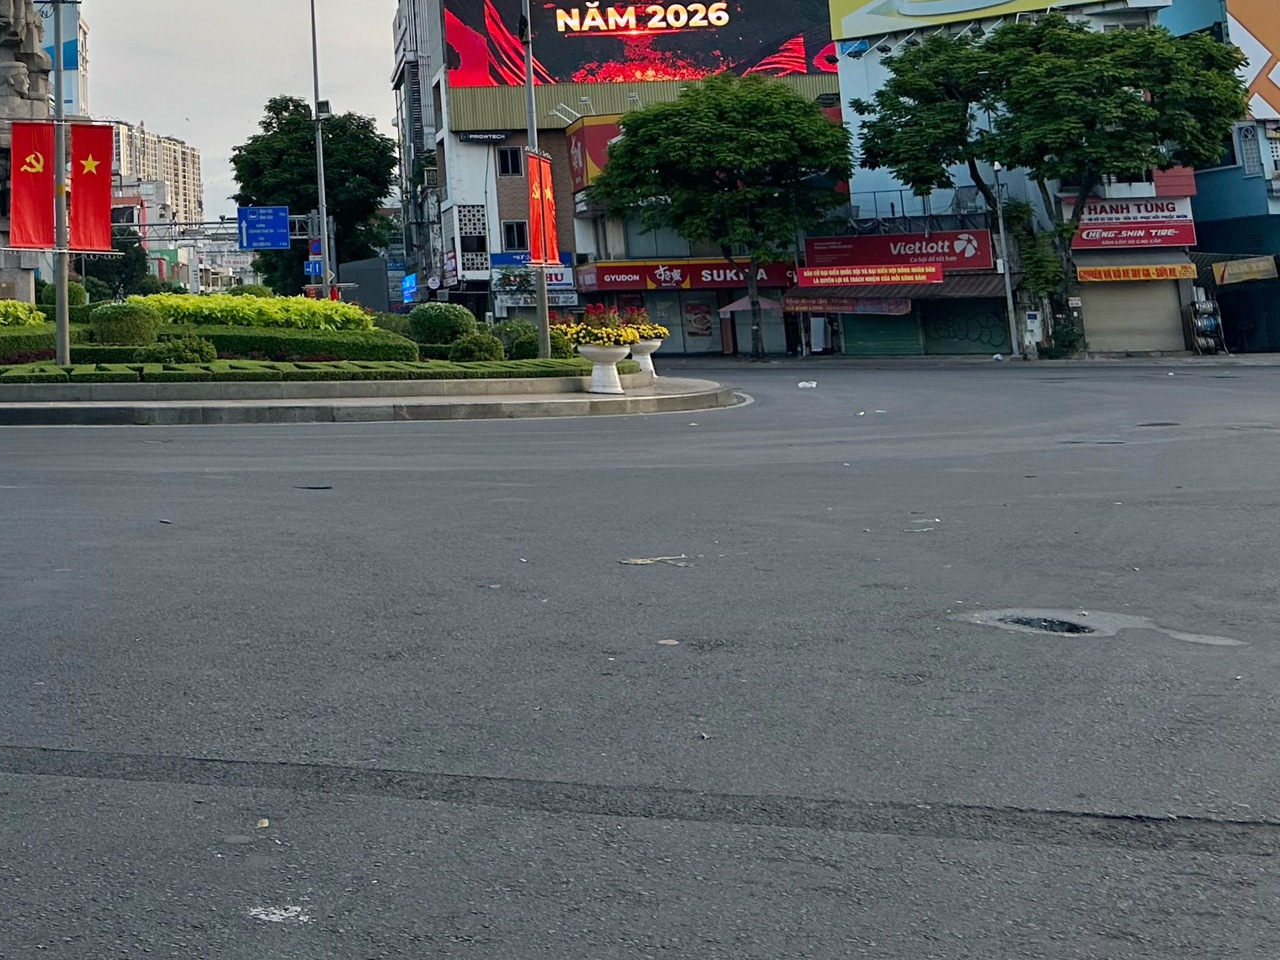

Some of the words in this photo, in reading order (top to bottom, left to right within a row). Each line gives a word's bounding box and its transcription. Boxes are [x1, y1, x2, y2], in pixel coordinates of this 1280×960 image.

[556, 2, 637, 32] NĂM
[647, 2, 730, 29] 2026
[1133, 200, 1176, 213] TÙNG
[1081, 228, 1119, 240] CHENG
[1118, 229, 1145, 238] SHIN
[1149, 228, 1179, 236] TIRE
[890, 240, 950, 255] Vietlott
[604, 274, 640, 282] GYUDON
[701, 268, 768, 282] SUKIA
